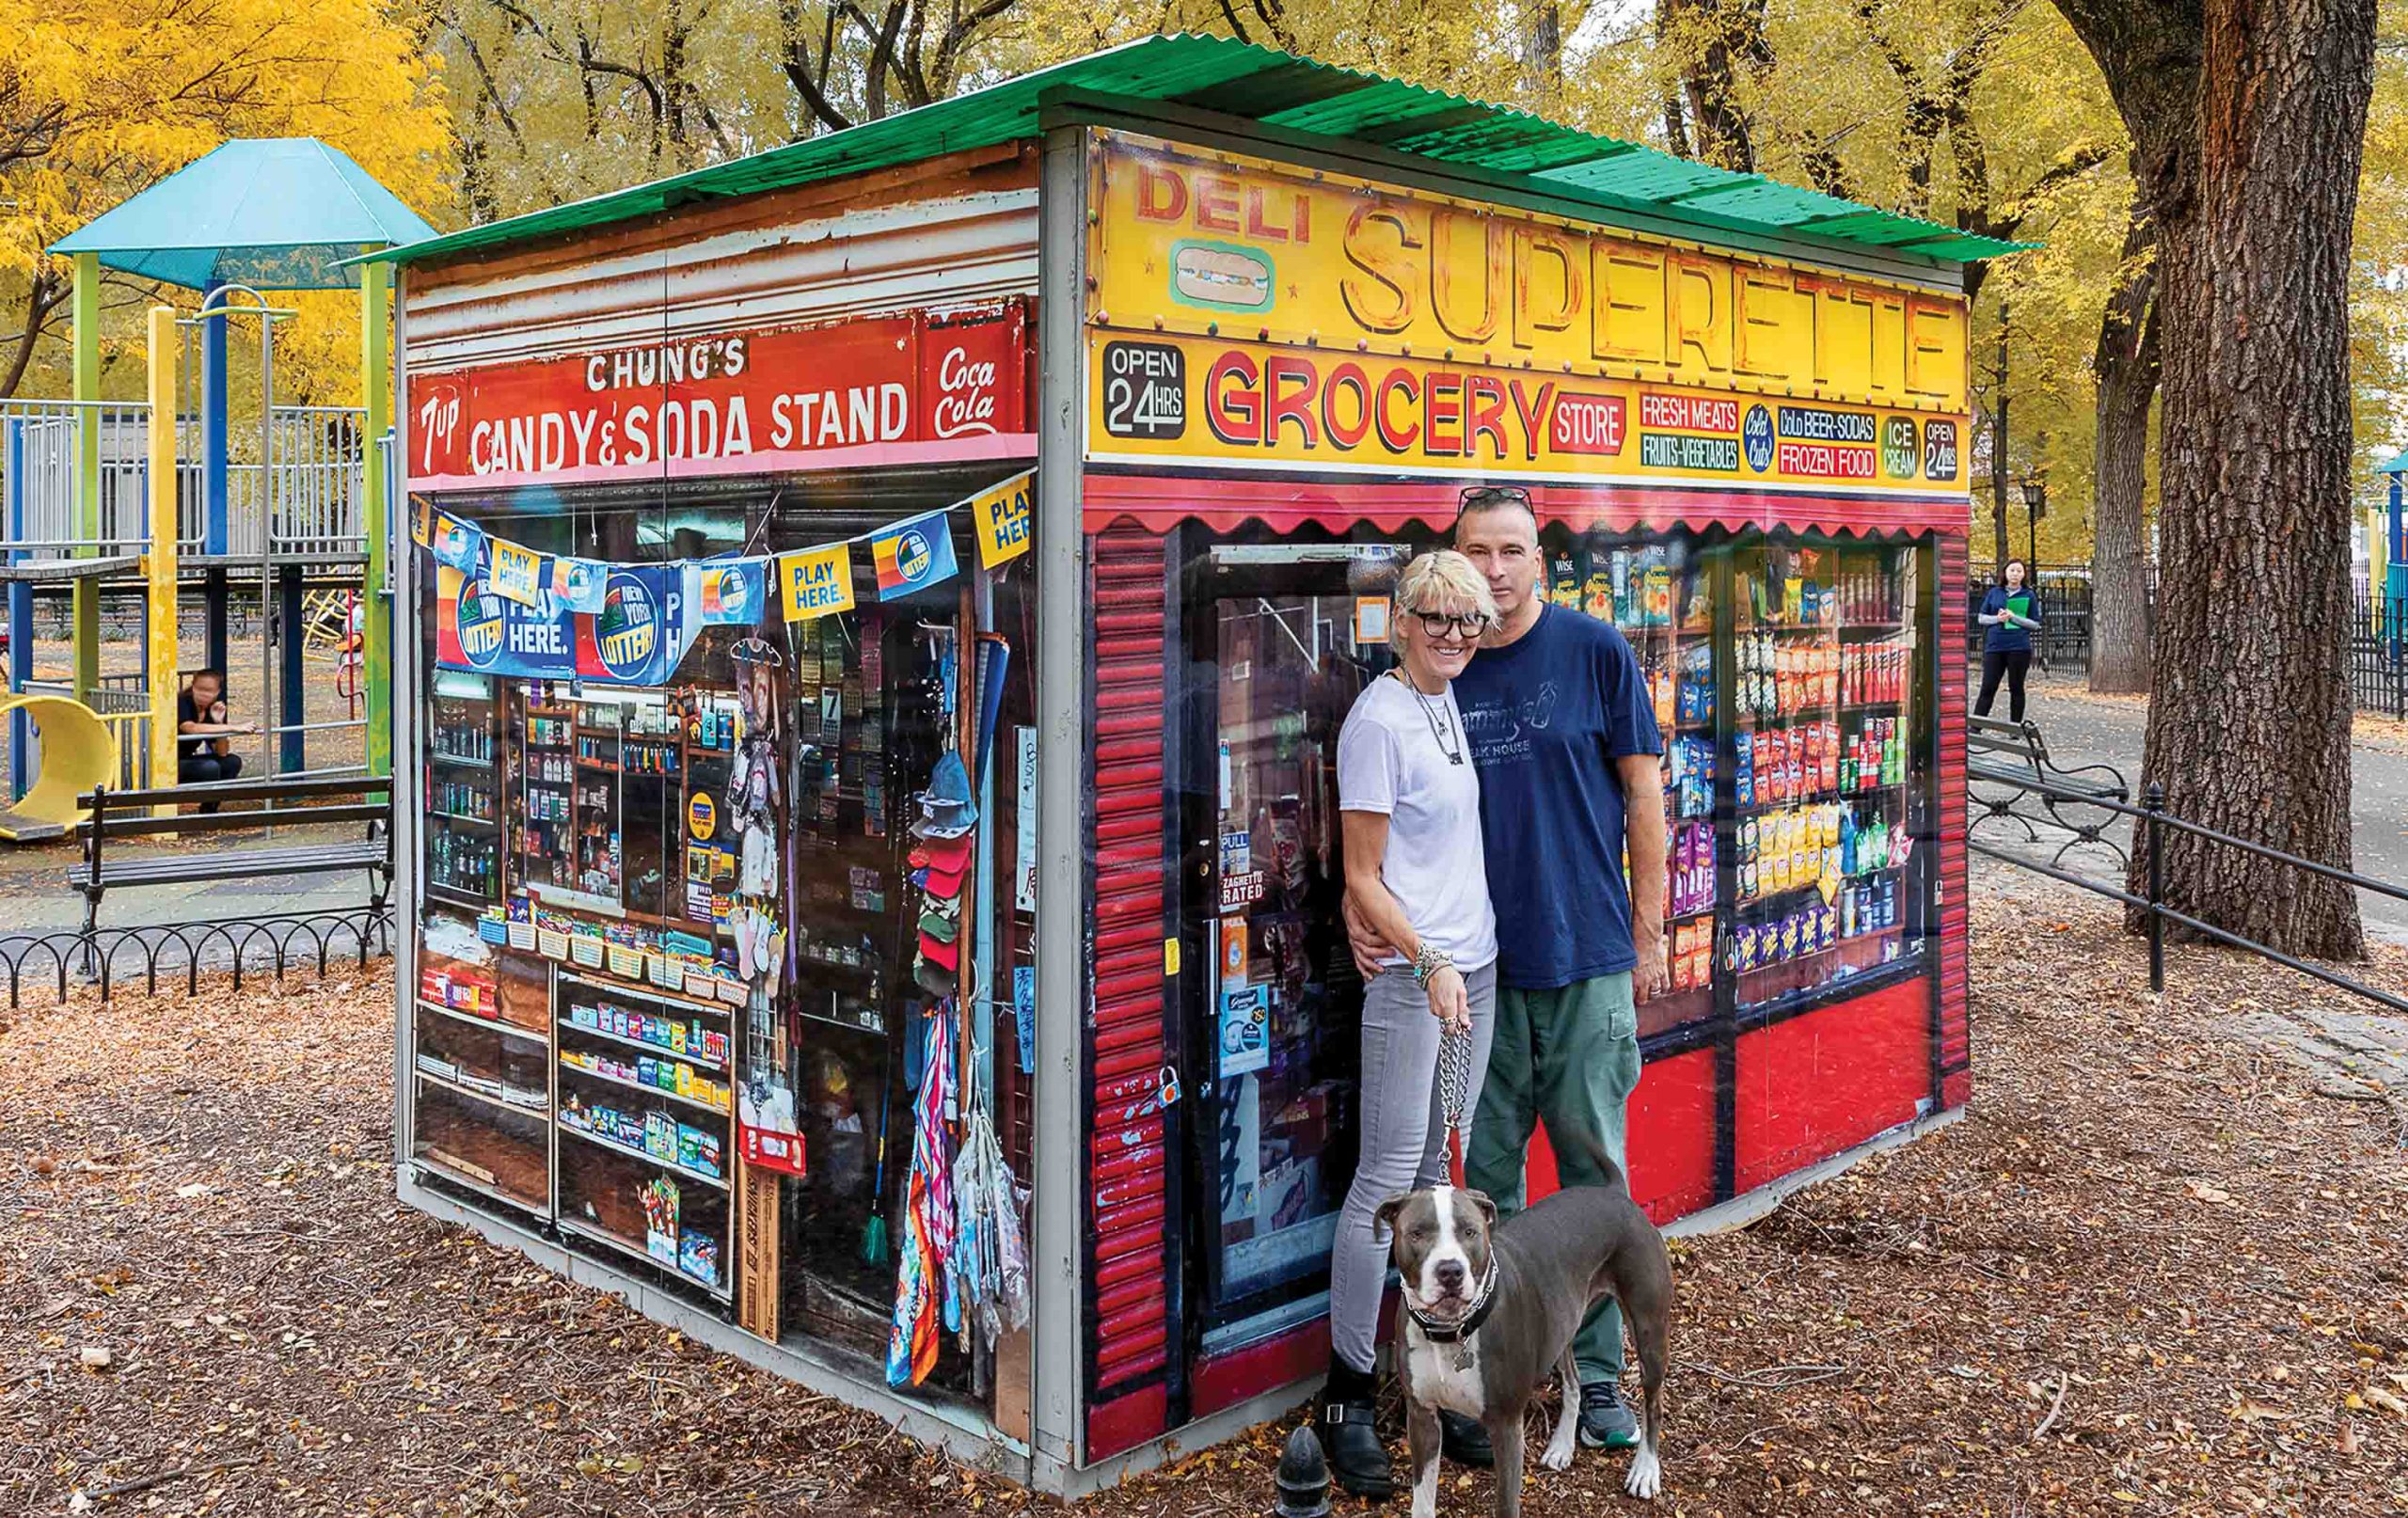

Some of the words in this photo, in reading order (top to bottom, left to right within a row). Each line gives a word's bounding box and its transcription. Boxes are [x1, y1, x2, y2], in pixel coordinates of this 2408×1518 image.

[1135, 164, 1310, 245] DELI
[587, 339, 744, 391] CHUNG'S
[940, 346, 995, 392] Coca
[1111, 347, 1177, 378] OPEN
[934, 386, 997, 438] Cola
[1205, 350, 1555, 461] GROCERY
[1557, 403, 1619, 447] STORE
[1642, 396, 1688, 427] FRESH
[1691, 399, 1736, 431] MEATS
[471, 409, 597, 476] CANDY
[624, 396, 752, 466] SODA
[770, 382, 909, 449] STAND
[1888, 421, 1912, 447] ICE
[1926, 423, 1954, 441] OPEN
[1781, 445, 1834, 474] FROZEN
[1839, 449, 1874, 476] FOOD
[1884, 448, 1916, 477] CREAM
[501, 548, 530, 570] PLAY
[1555, 560, 1574, 573] WISE
[793, 561, 835, 587] PLAY
[621, 585, 645, 602] NEW
[796, 583, 846, 609] HERE.
[624, 602, 653, 626] YORK
[509, 623, 569, 655] HERE.
[600, 622, 655, 665] LOTTERY
[1493, 739, 1529, 756] HOUSE
[1221, 835, 1247, 849] PULL
[1223, 883, 1263, 904] RATED
